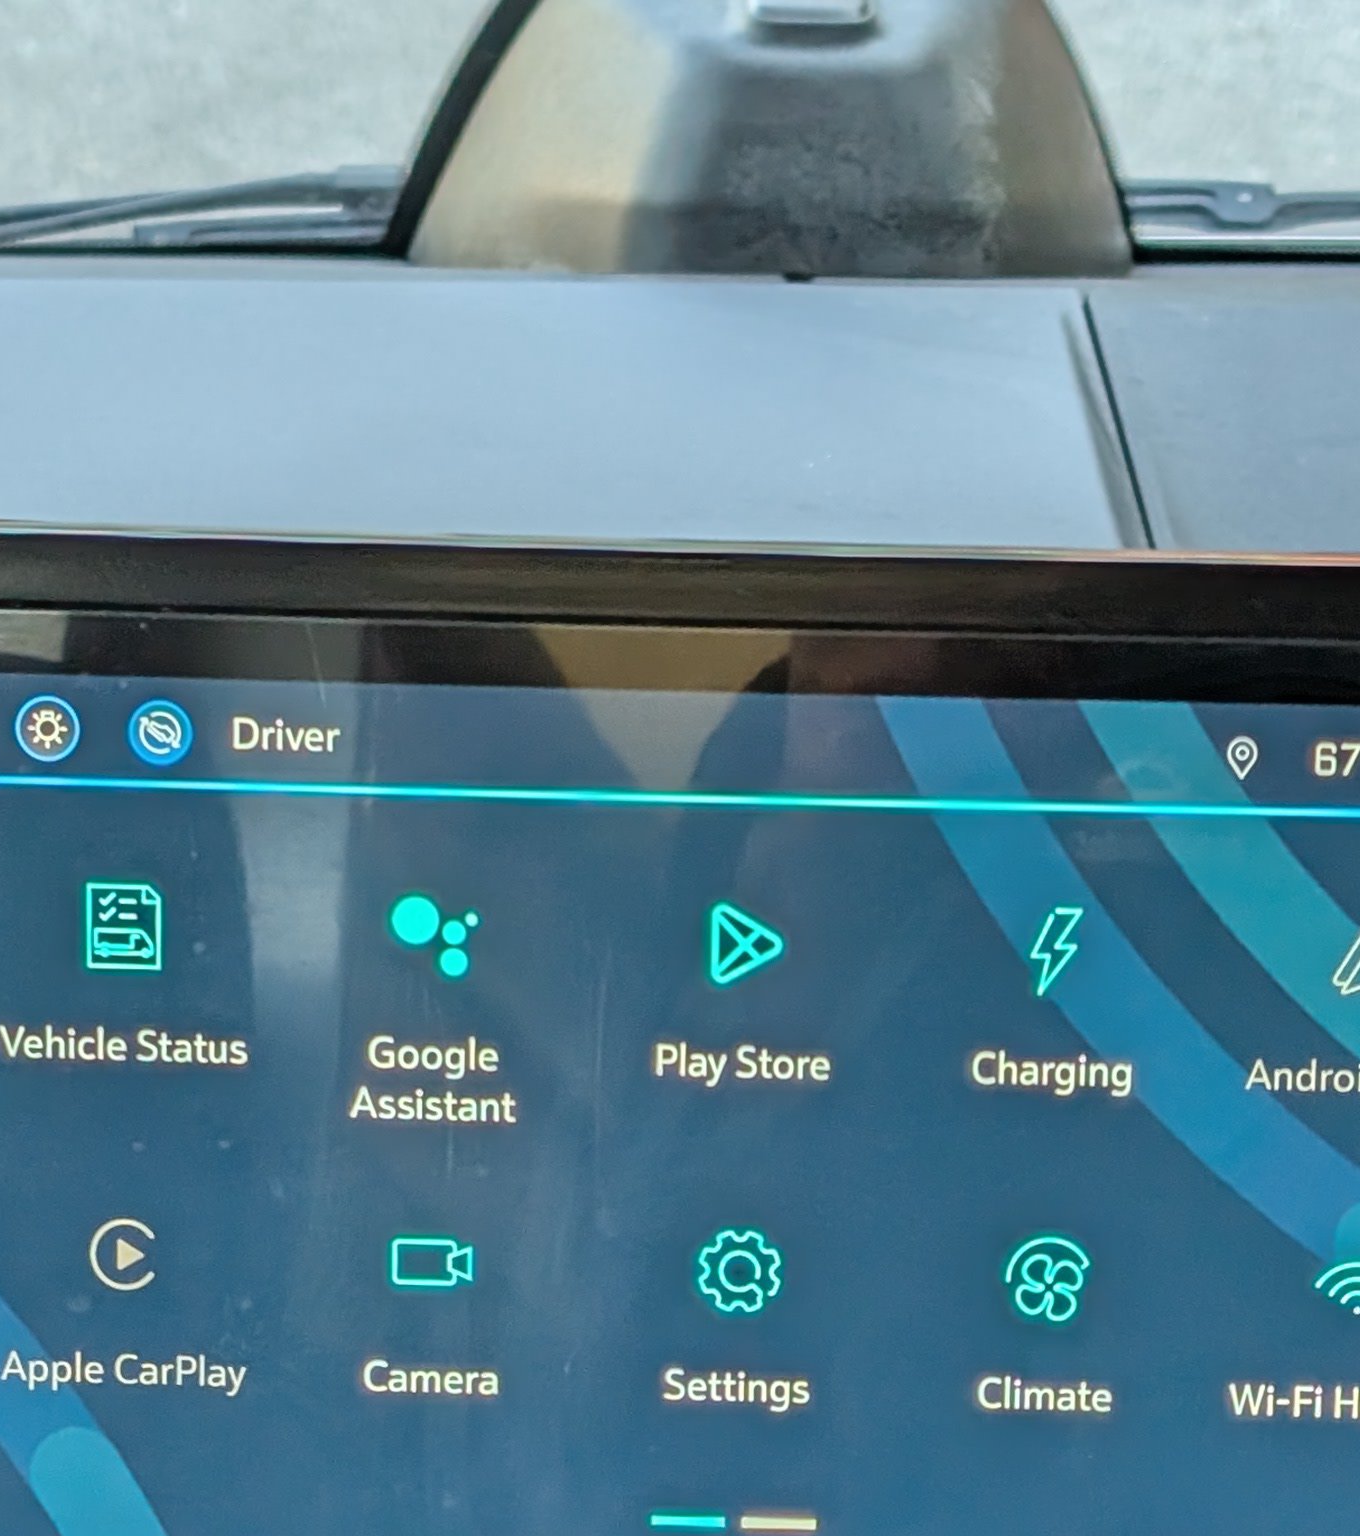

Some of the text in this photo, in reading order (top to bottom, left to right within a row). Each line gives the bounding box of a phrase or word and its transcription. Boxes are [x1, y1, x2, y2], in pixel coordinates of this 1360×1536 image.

[231, 716, 341, 754] Driver
[135, 1029, 249, 1066] Status
[368, 1036, 500, 1077] Google
[655, 1041, 832, 1085] Play Store
[972, 1050, 1133, 1098] Charging
[349, 1085, 518, 1124] Assistant
[0, 1350, 248, 1398] Apple CarPlay
[363, 1359, 500, 1396] Camera
[662, 1367, 811, 1413] Settings
[977, 1375, 1114, 1413] Climate
[1228, 1382, 1324, 1420] Wi-Fi
